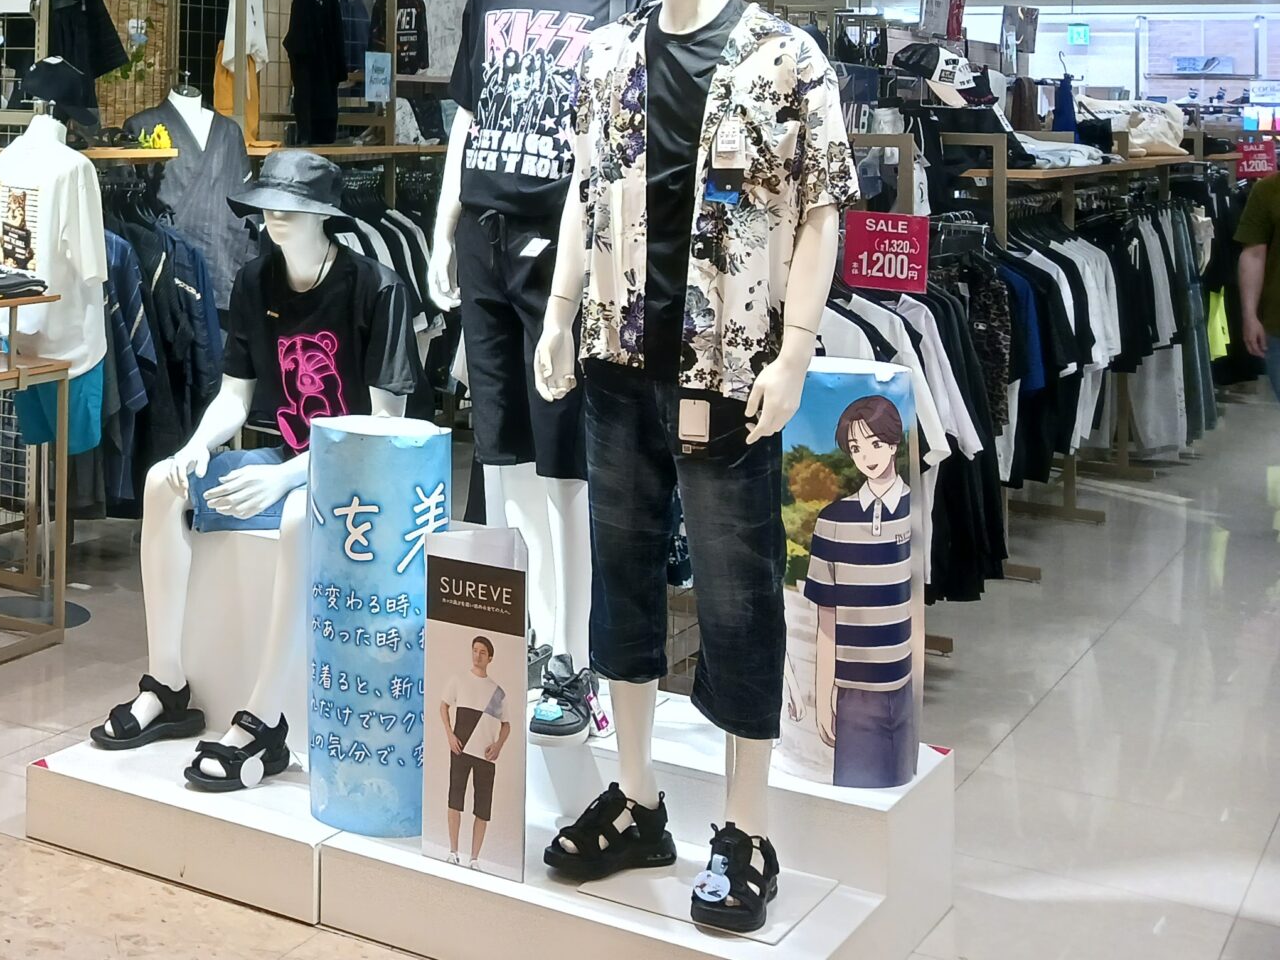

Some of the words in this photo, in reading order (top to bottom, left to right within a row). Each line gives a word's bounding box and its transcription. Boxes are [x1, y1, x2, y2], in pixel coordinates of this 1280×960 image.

[485, 9, 595, 70] KISS
[1243, 144, 1265, 152] SALE
[865, 218, 908, 234] SALE
[439, 576, 513, 606] SUREVE
[311, 694, 424, 734] だけでワク
